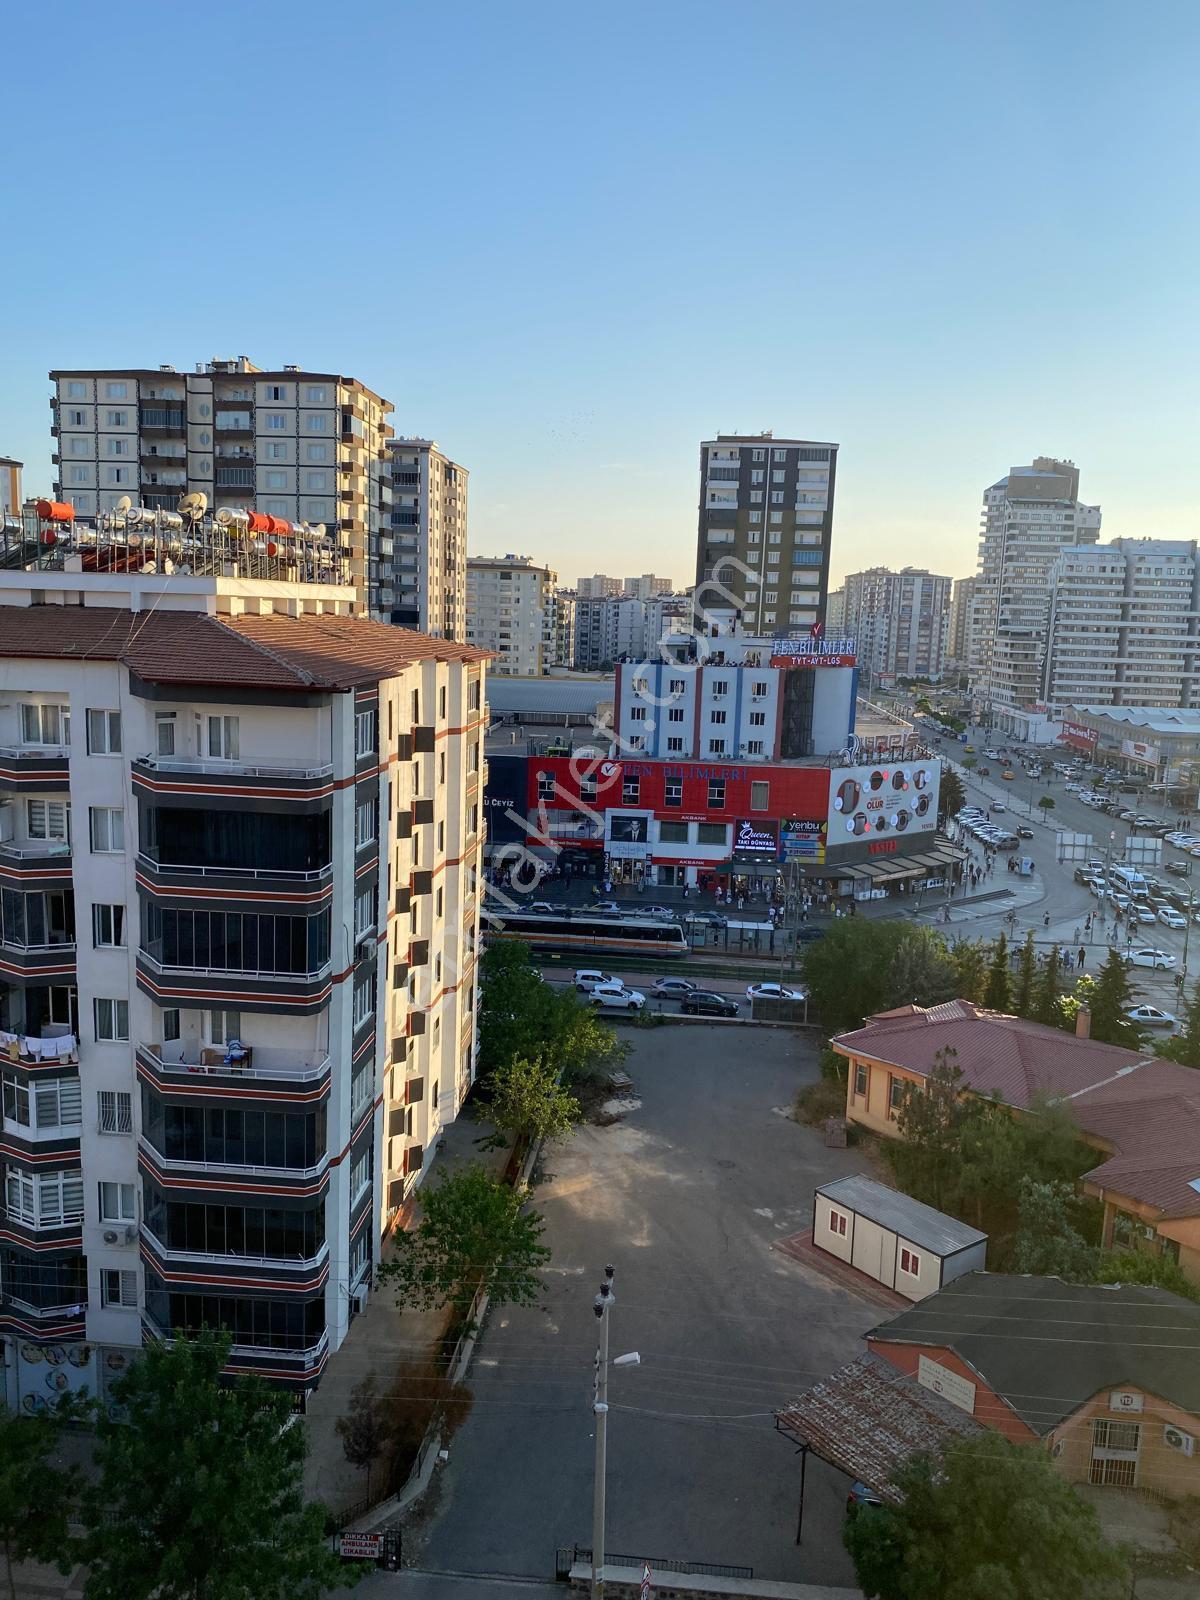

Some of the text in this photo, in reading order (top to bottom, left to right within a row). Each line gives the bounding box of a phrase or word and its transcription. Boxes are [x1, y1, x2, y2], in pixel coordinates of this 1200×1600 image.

[773, 640, 796, 655] FEN
[791, 656, 841, 665] TYT-AYT-LGS
[866, 800, 884, 810] OLUR
[789, 821, 820, 831] yenbu
[740, 827, 772, 839] Queen
